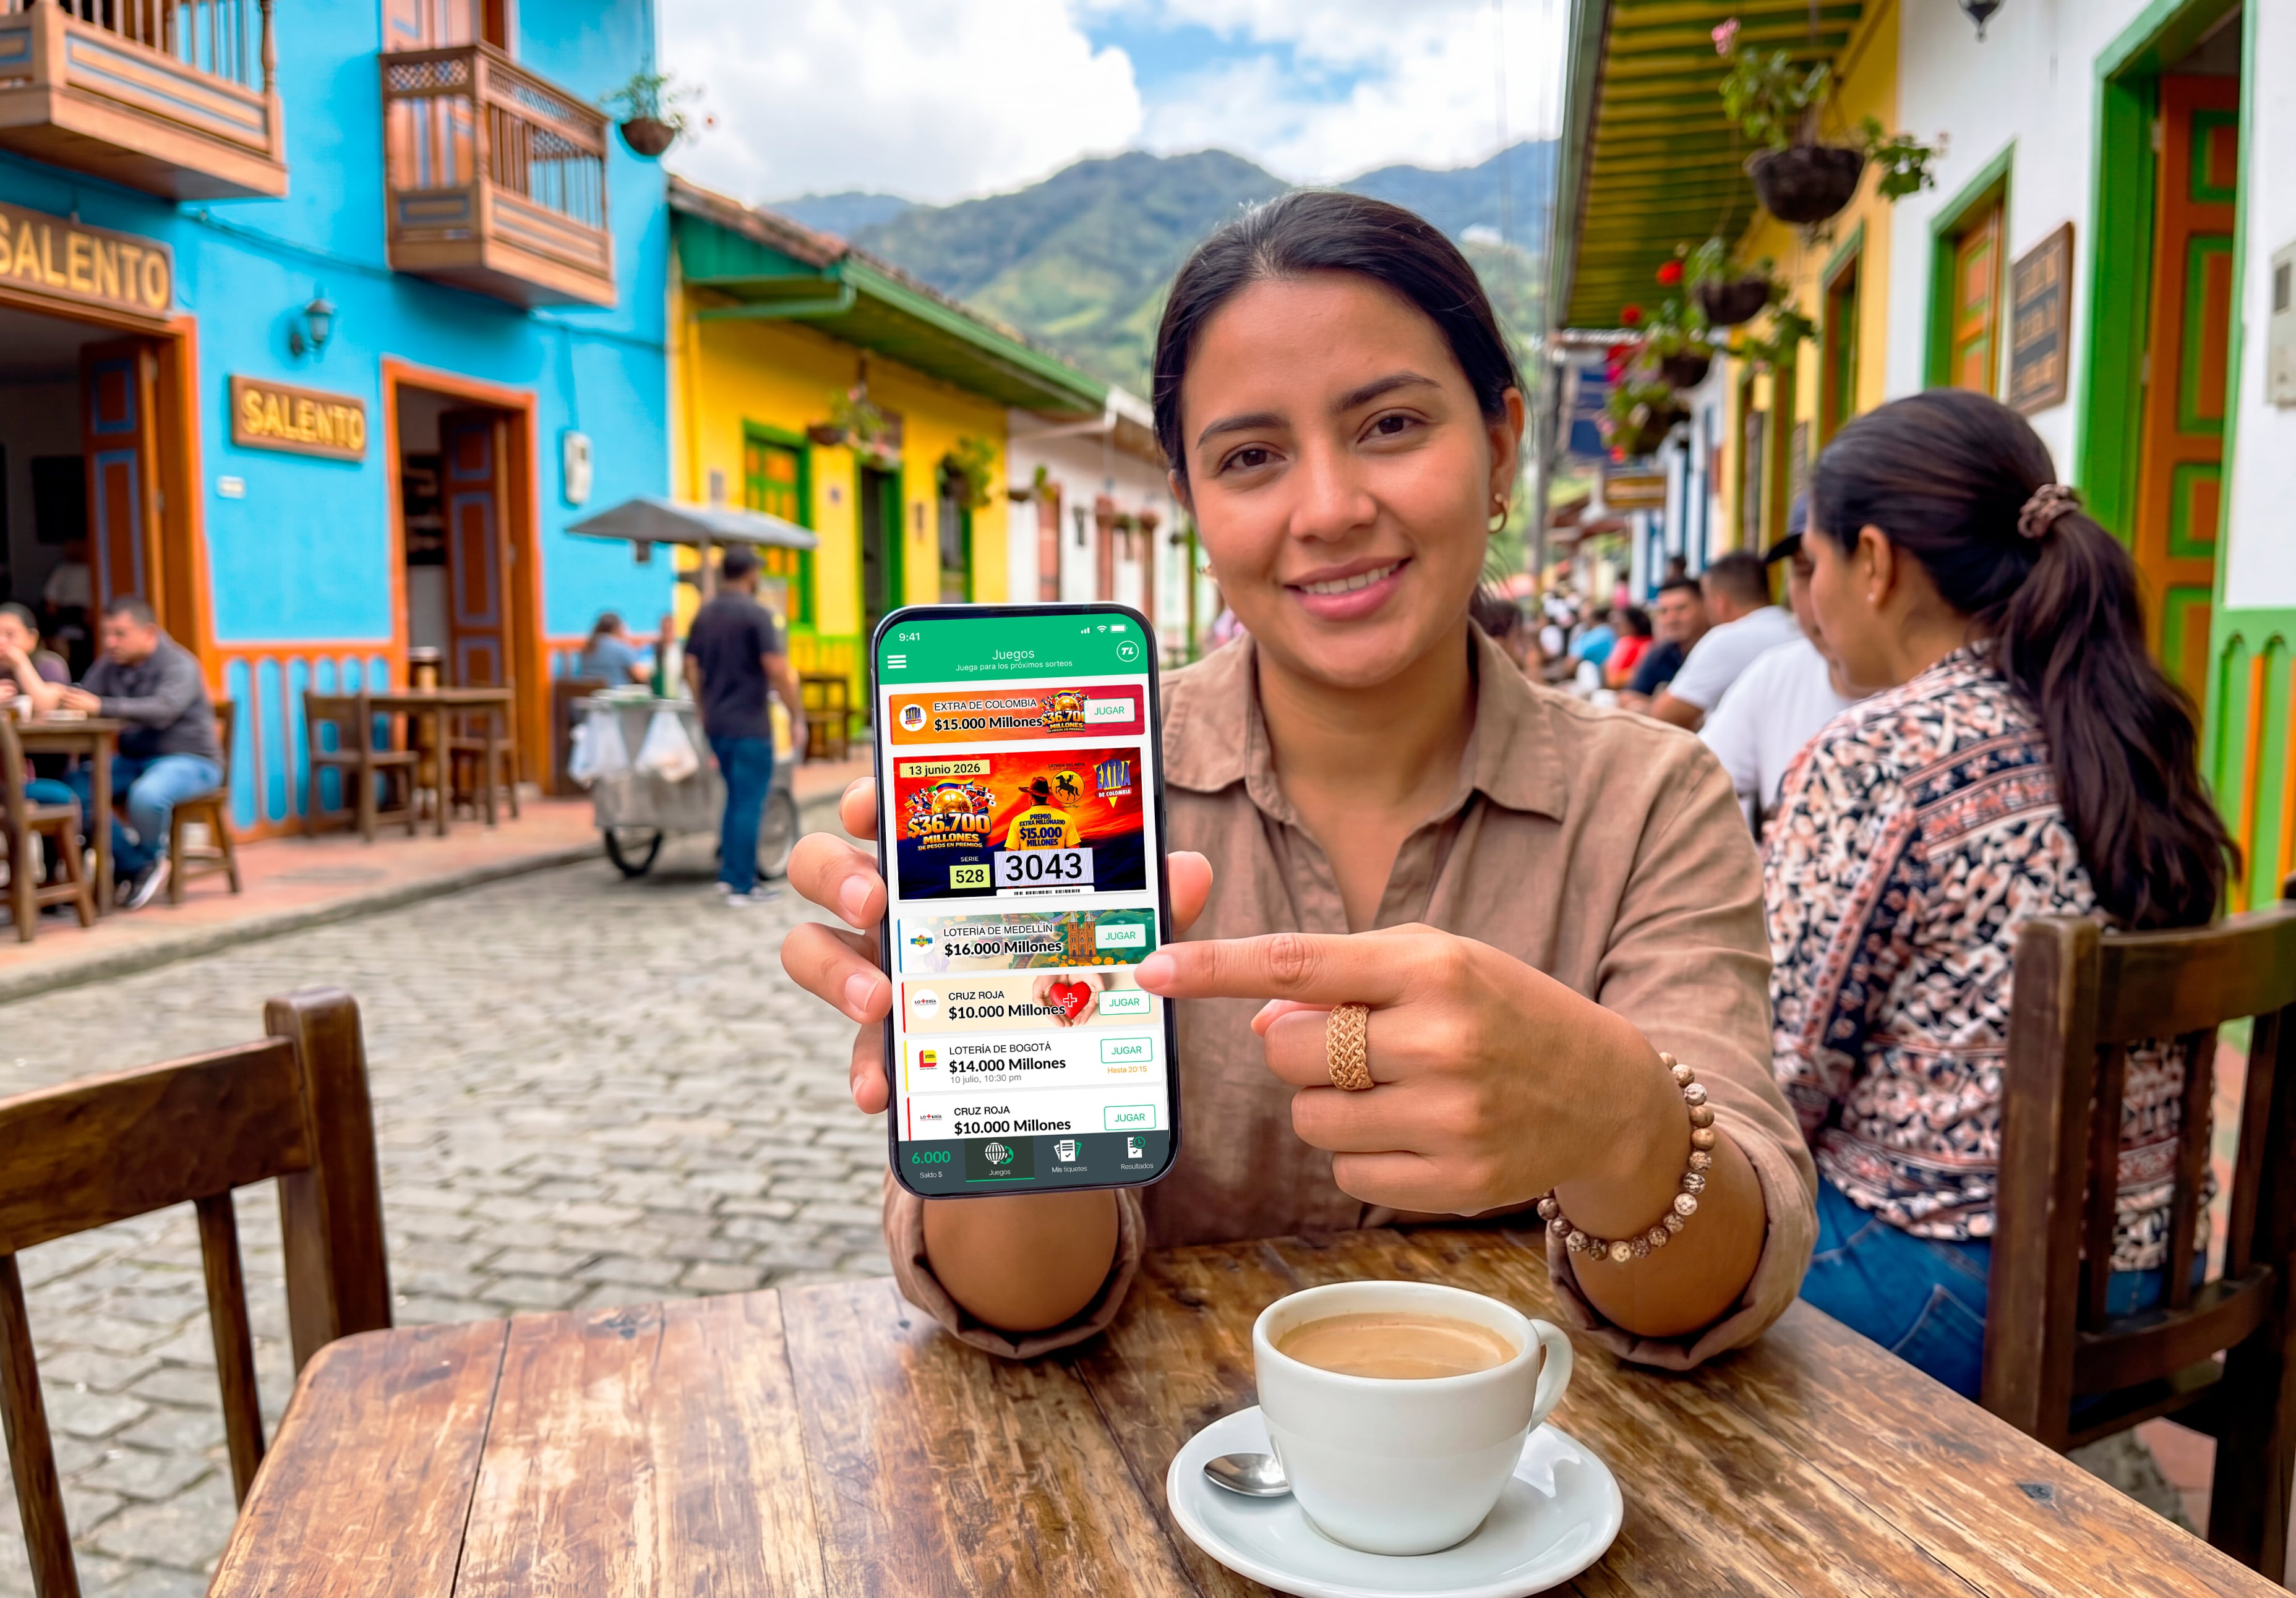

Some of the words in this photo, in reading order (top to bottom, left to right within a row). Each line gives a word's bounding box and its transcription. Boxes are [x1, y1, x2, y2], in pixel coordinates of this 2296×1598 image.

[241, 389, 366, 451] SALENTO
[899, 632, 920, 641] 9:41
[992, 649, 1035, 661] Juegos
[1010, 661, 1043, 670] próximos
[934, 702, 967, 711] EXTRA
[969, 701, 982, 709] DE
[985, 699, 1037, 709] COLOMBIA
[1094, 706, 1124, 715] JUGAR
[934, 717, 985, 732] $15.000
[989, 716, 1042, 728] Millones
[909, 766, 922, 775] 13
[925, 765, 951, 777] junio
[953, 763, 980, 773] 2026
[1096, 759, 1131, 789] EXTRA
[907, 813, 991, 839] $36.700
[923, 833, 979, 844] MILLONES
[1019, 827, 1062, 841] $15.000
[1027, 839, 1058, 847] MILLONES
[1006, 852, 1082, 881] 3043
[956, 869, 984, 883] 528
[944, 926, 985, 936] LOTERÍA
[988, 927, 1001, 935] DE
[1004, 923, 1053, 934] MEDELLÍN
[1105, 931, 1136, 940] JUGAR
[945, 942, 1000, 957] $16.000
[1004, 941, 1062, 954] Millones
[948, 992, 976, 1001] CRUZ
[979, 991, 1004, 999] ROJA
[1109, 998, 1139, 1007] JUGAR
[949, 1006, 1004, 1020] $10.000
[1008, 1004, 1065, 1017] Millones
[949, 1044, 991, 1054] LOTERÍA
[993, 1045, 1006, 1053] DE
[1009, 1041, 1052, 1053] BOGOTÁ
[1112, 1046, 1142, 1055] JUGAR
[949, 1060, 1004, 1074] $14.000
[1009, 1058, 1066, 1070] Millones
[962, 1075, 982, 1085] julio,
[984, 1074, 1006, 1082] 10:30
[1009, 1075, 1022, 1083] pm
[954, 1107, 982, 1116] CRUZ
[984, 1106, 1010, 1114] ROJA
[1115, 1114, 1145, 1122] JUGAR
[954, 1121, 1009, 1136] $10.000
[1014, 1119, 1071, 1132] Millones
[911, 1150, 951, 1164] 6.000
[1063, 1166, 1087, 1174] tiquetes
